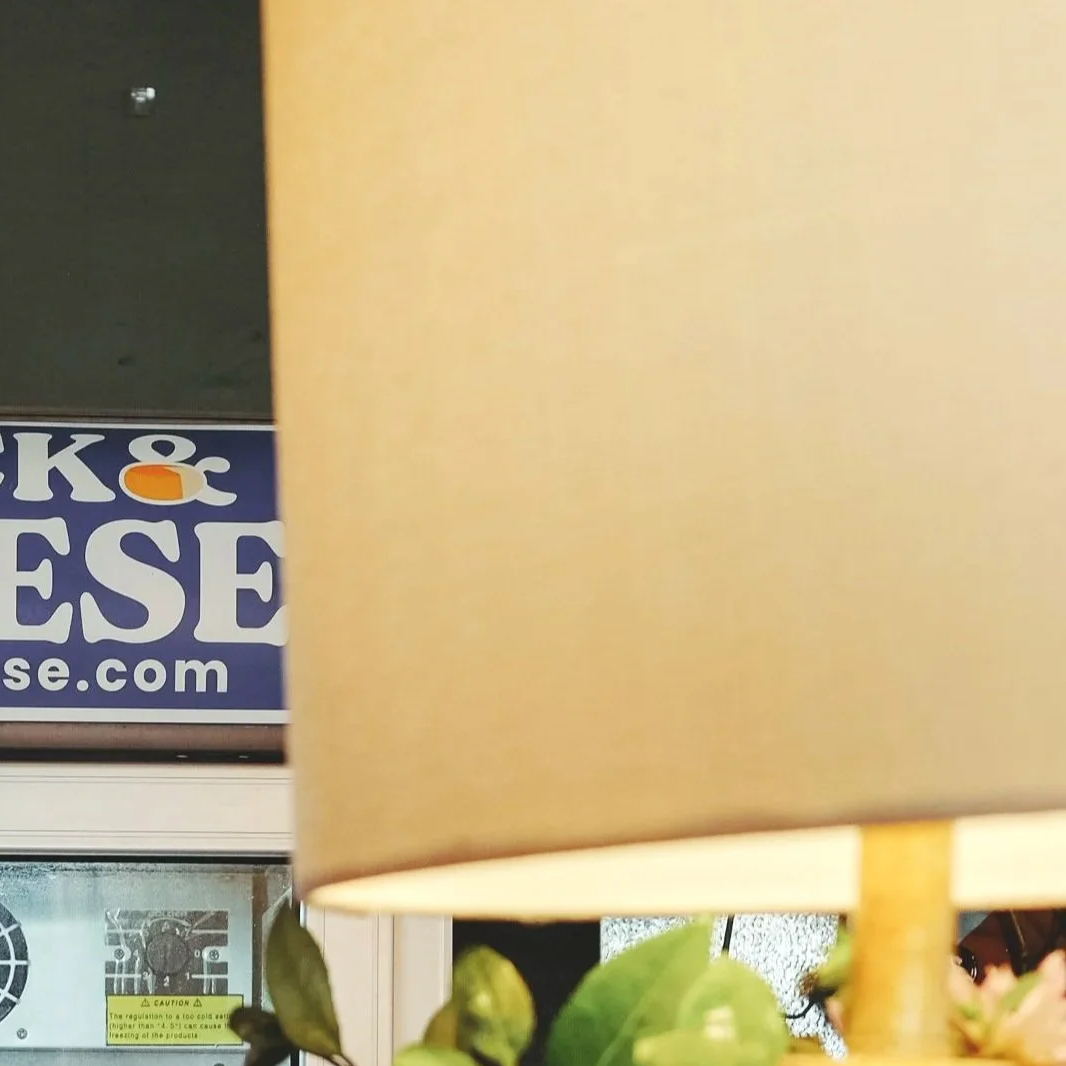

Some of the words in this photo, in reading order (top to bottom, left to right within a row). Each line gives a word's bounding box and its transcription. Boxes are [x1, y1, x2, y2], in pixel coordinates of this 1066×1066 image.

[109, 1012, 123, 1020] The
[125, 1012, 162, 1022] regulation
[165, 1012, 174, 1020] to
[197, 1012, 213, 1020] cold
[138, 1022, 155, 1030] than
[109, 1031, 139, 1041] freezing
[151, 1031, 164, 1039] the
[166, 1032, 198, 1041] products
